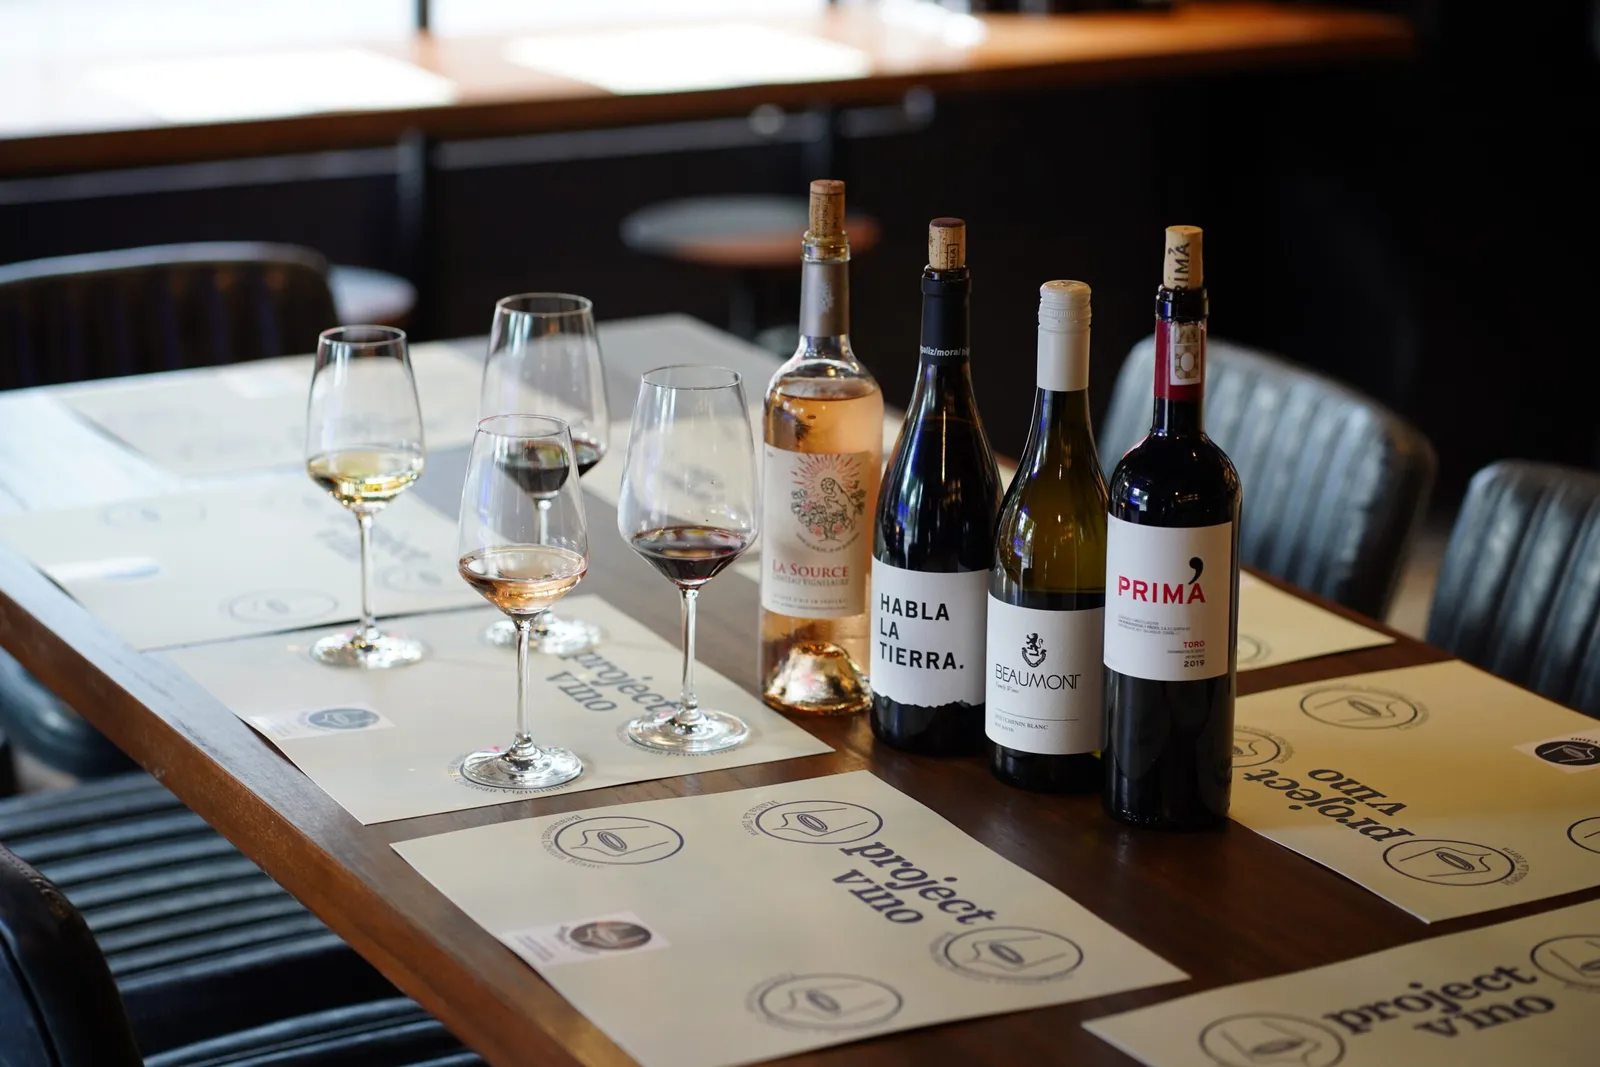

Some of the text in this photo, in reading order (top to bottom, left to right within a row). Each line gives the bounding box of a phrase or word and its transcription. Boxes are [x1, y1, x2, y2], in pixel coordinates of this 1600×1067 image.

[880, 592, 950, 621] HABLA
[880, 617, 900, 640] LA
[1183, 640, 1206, 649] TORO
[880, 640, 965, 670] TIERRA.
[1183, 659, 1206, 668] 2019
[546, 671, 618, 712] vino
[557, 651, 684, 712] project
[995, 663, 1082, 690] BEAUMONT
[1026, 721, 1049, 731] BLANC
[1243, 769, 1416, 842] project
[1308, 769, 1408, 817] vino
[832, 868, 924, 924] vino
[838, 841, 997, 925] project
[1322, 963, 1538, 1036] project
[1413, 993, 1557, 1040] vino
